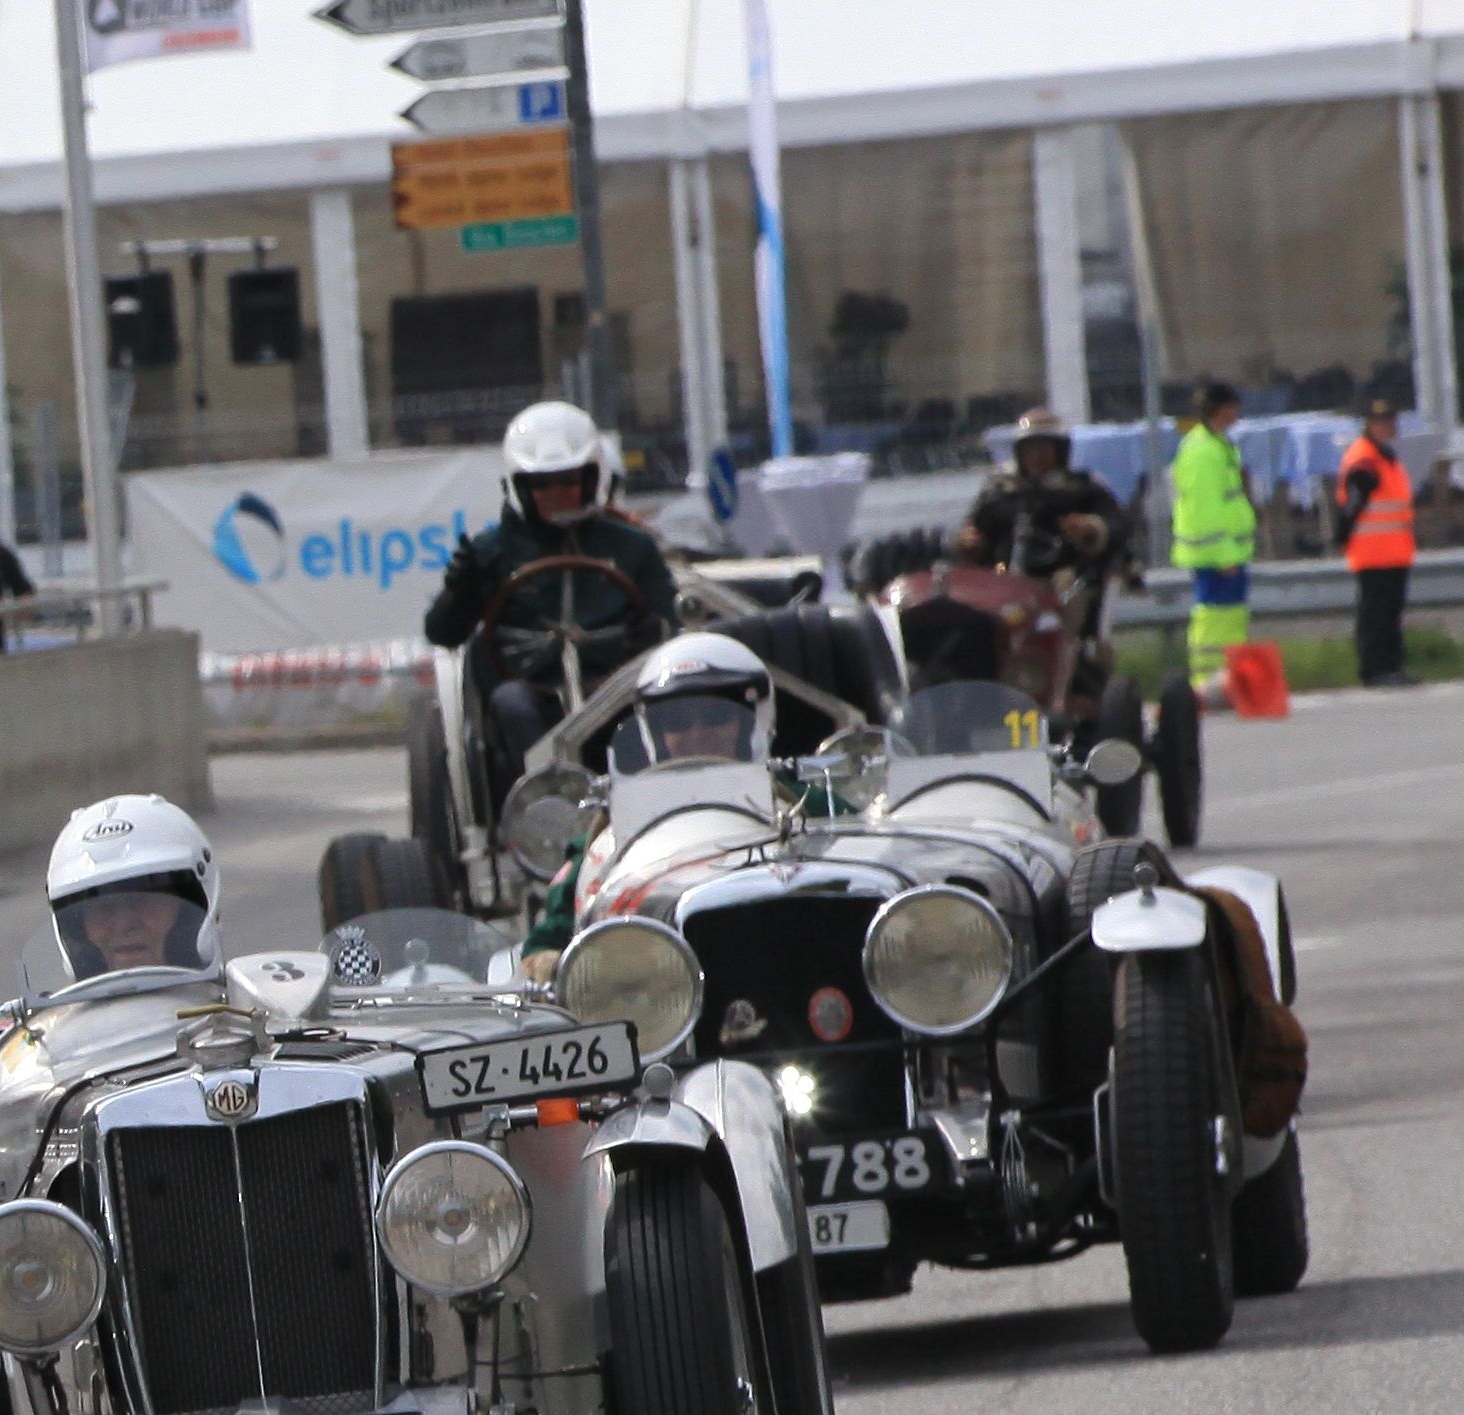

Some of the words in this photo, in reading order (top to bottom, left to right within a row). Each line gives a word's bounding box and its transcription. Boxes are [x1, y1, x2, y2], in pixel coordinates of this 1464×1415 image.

[1004, 709, 1039, 749] 11
[219, 1083, 245, 1112] MG
[795, 1137, 930, 1197] 788
[815, 1213, 848, 1243] 87
